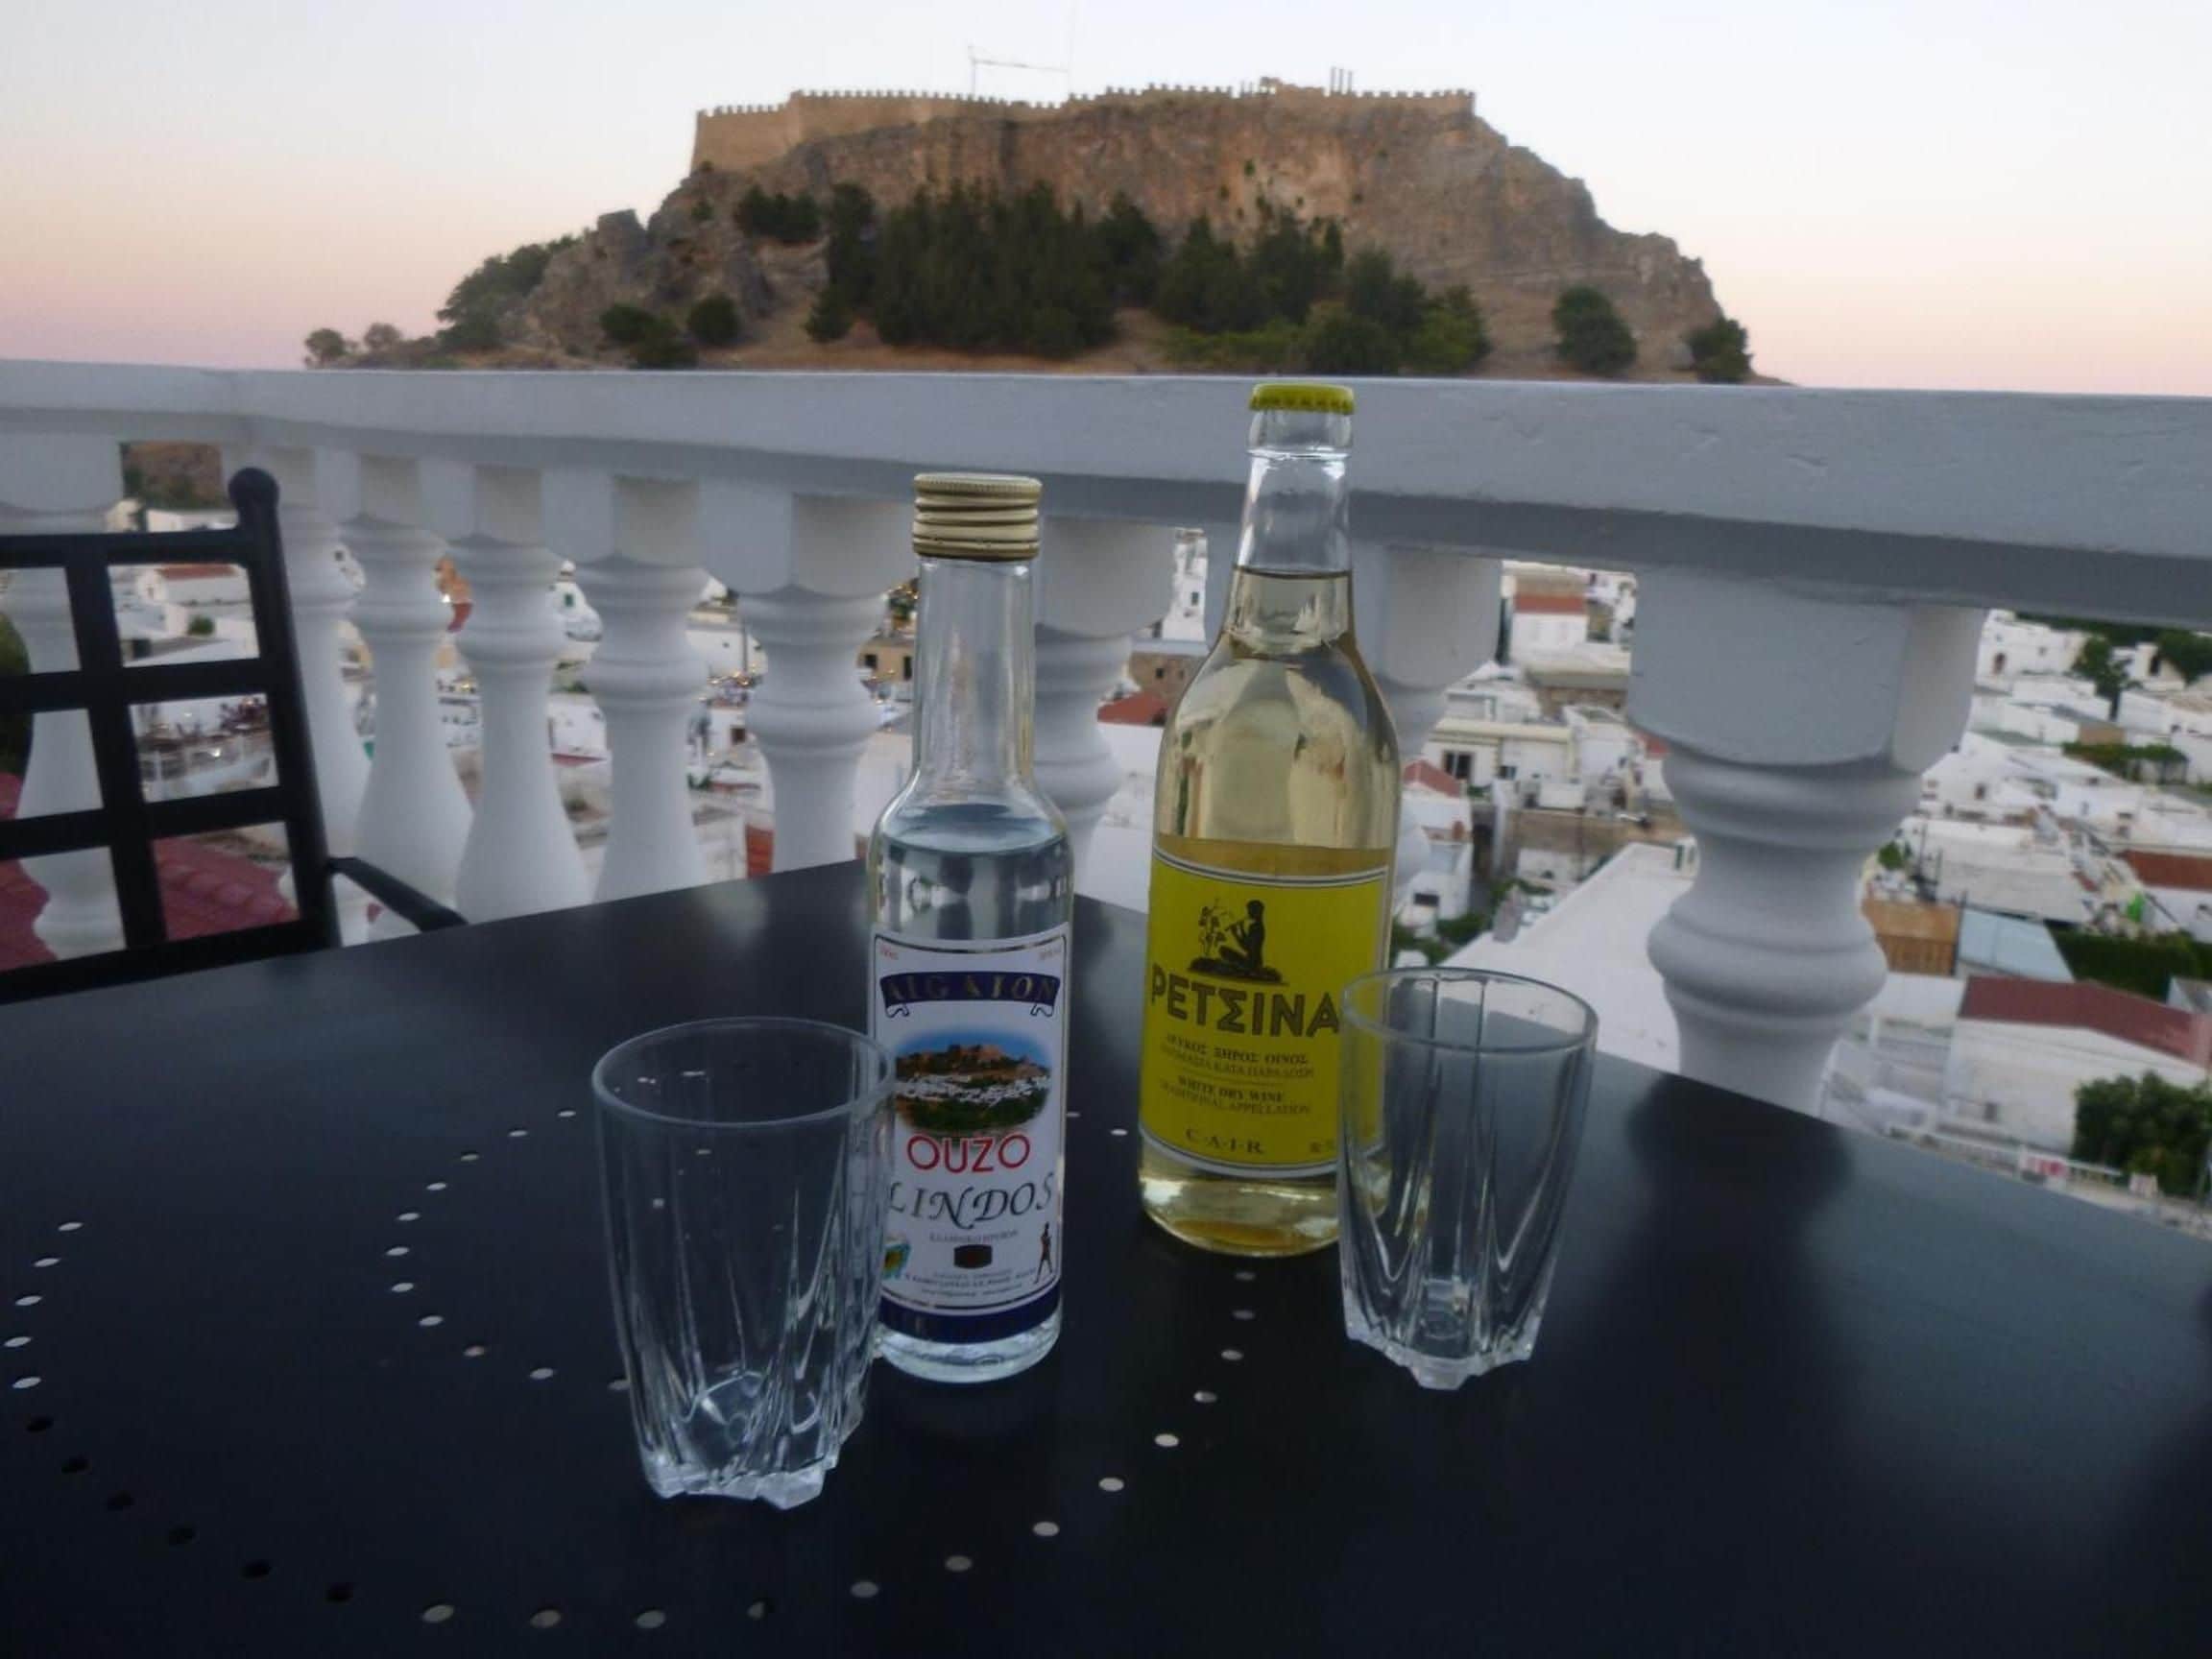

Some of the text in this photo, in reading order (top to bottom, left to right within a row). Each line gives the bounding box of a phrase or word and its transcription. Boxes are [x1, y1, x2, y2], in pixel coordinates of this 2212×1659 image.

[1151, 962, 1340, 1038] ΡΕΤΣΙΝΑ
[906, 1134, 1031, 1174] OUZO
[888, 1170, 1055, 1230] LINDOS
